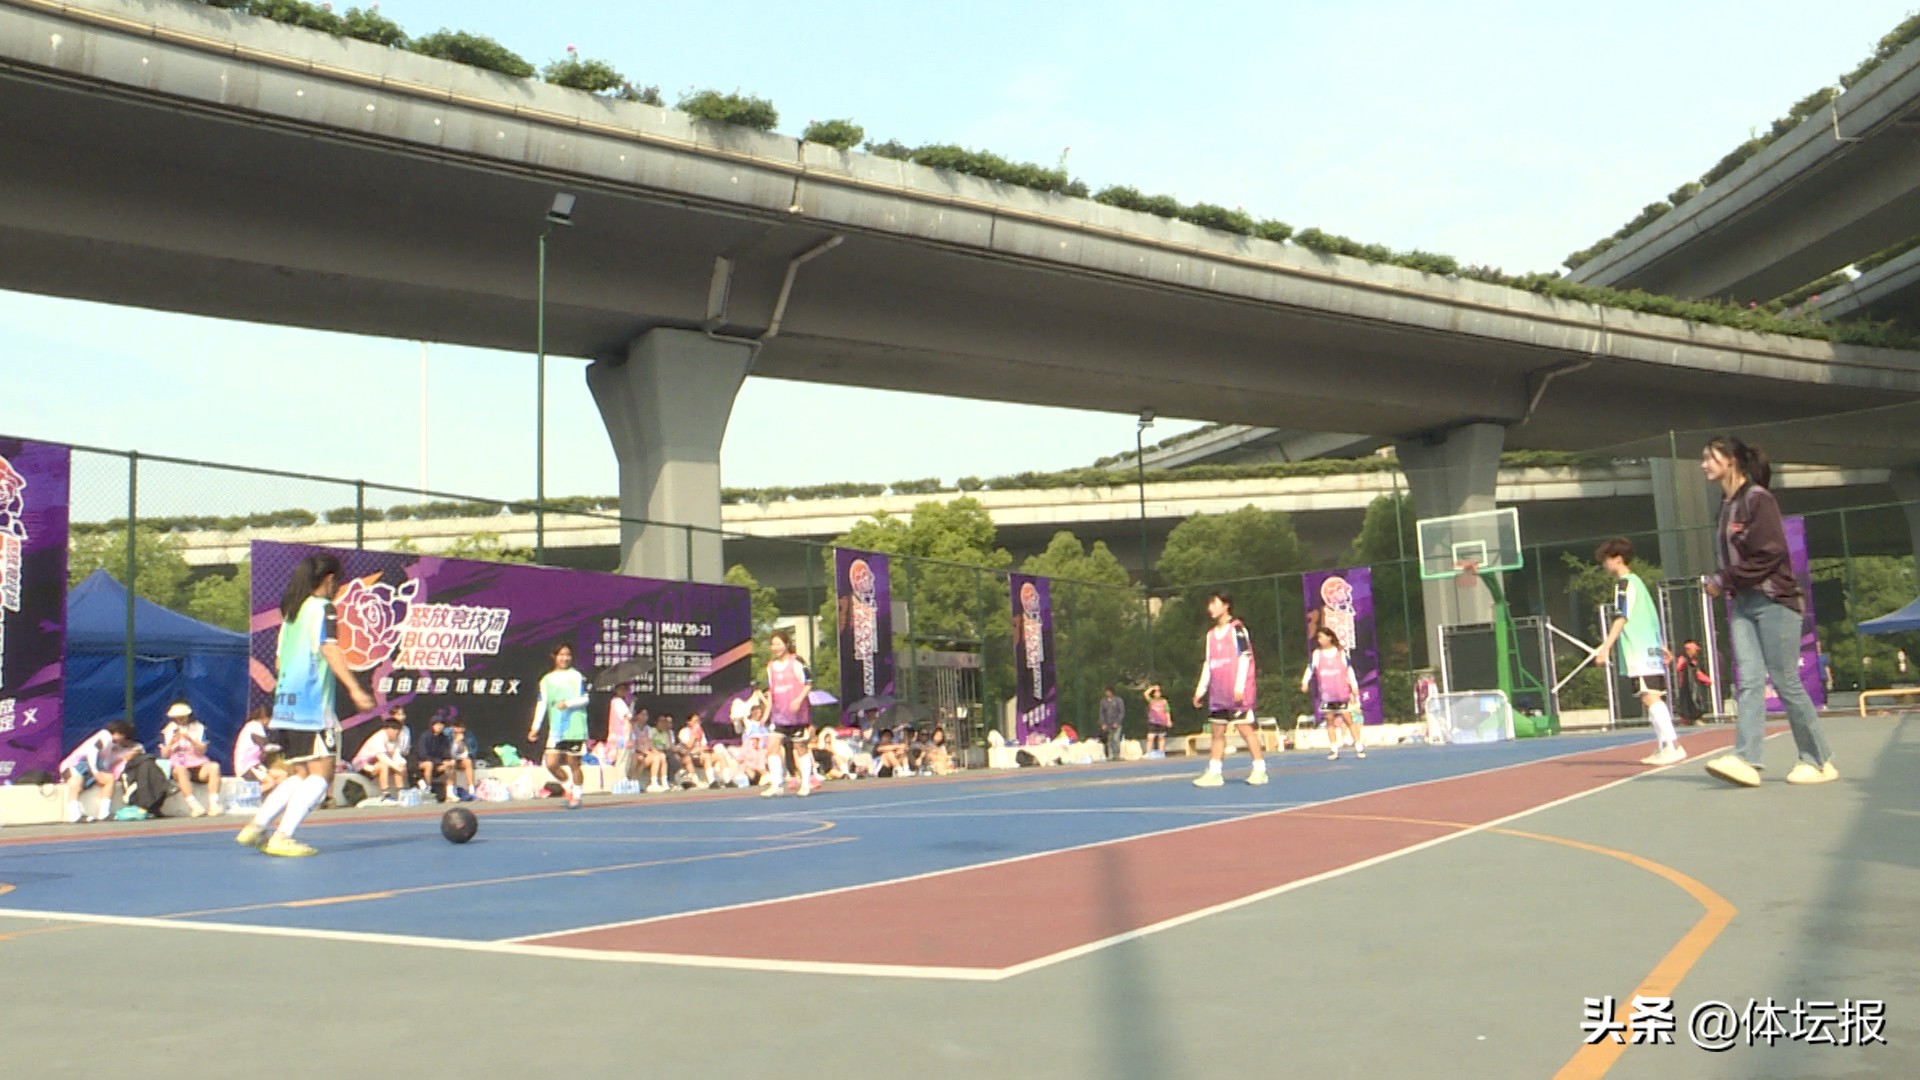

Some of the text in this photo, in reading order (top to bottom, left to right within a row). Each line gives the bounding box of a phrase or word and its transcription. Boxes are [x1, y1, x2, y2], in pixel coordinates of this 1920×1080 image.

[407, 606, 506, 632] 怒放竞技场
[661, 622, 711, 636] MAY 20-21
[403, 631, 499, 650] BLOOMING
[661, 637, 686, 650] 2023
[397, 651, 463, 667] ARENA
[455, 678, 521, 695] 不被定义
